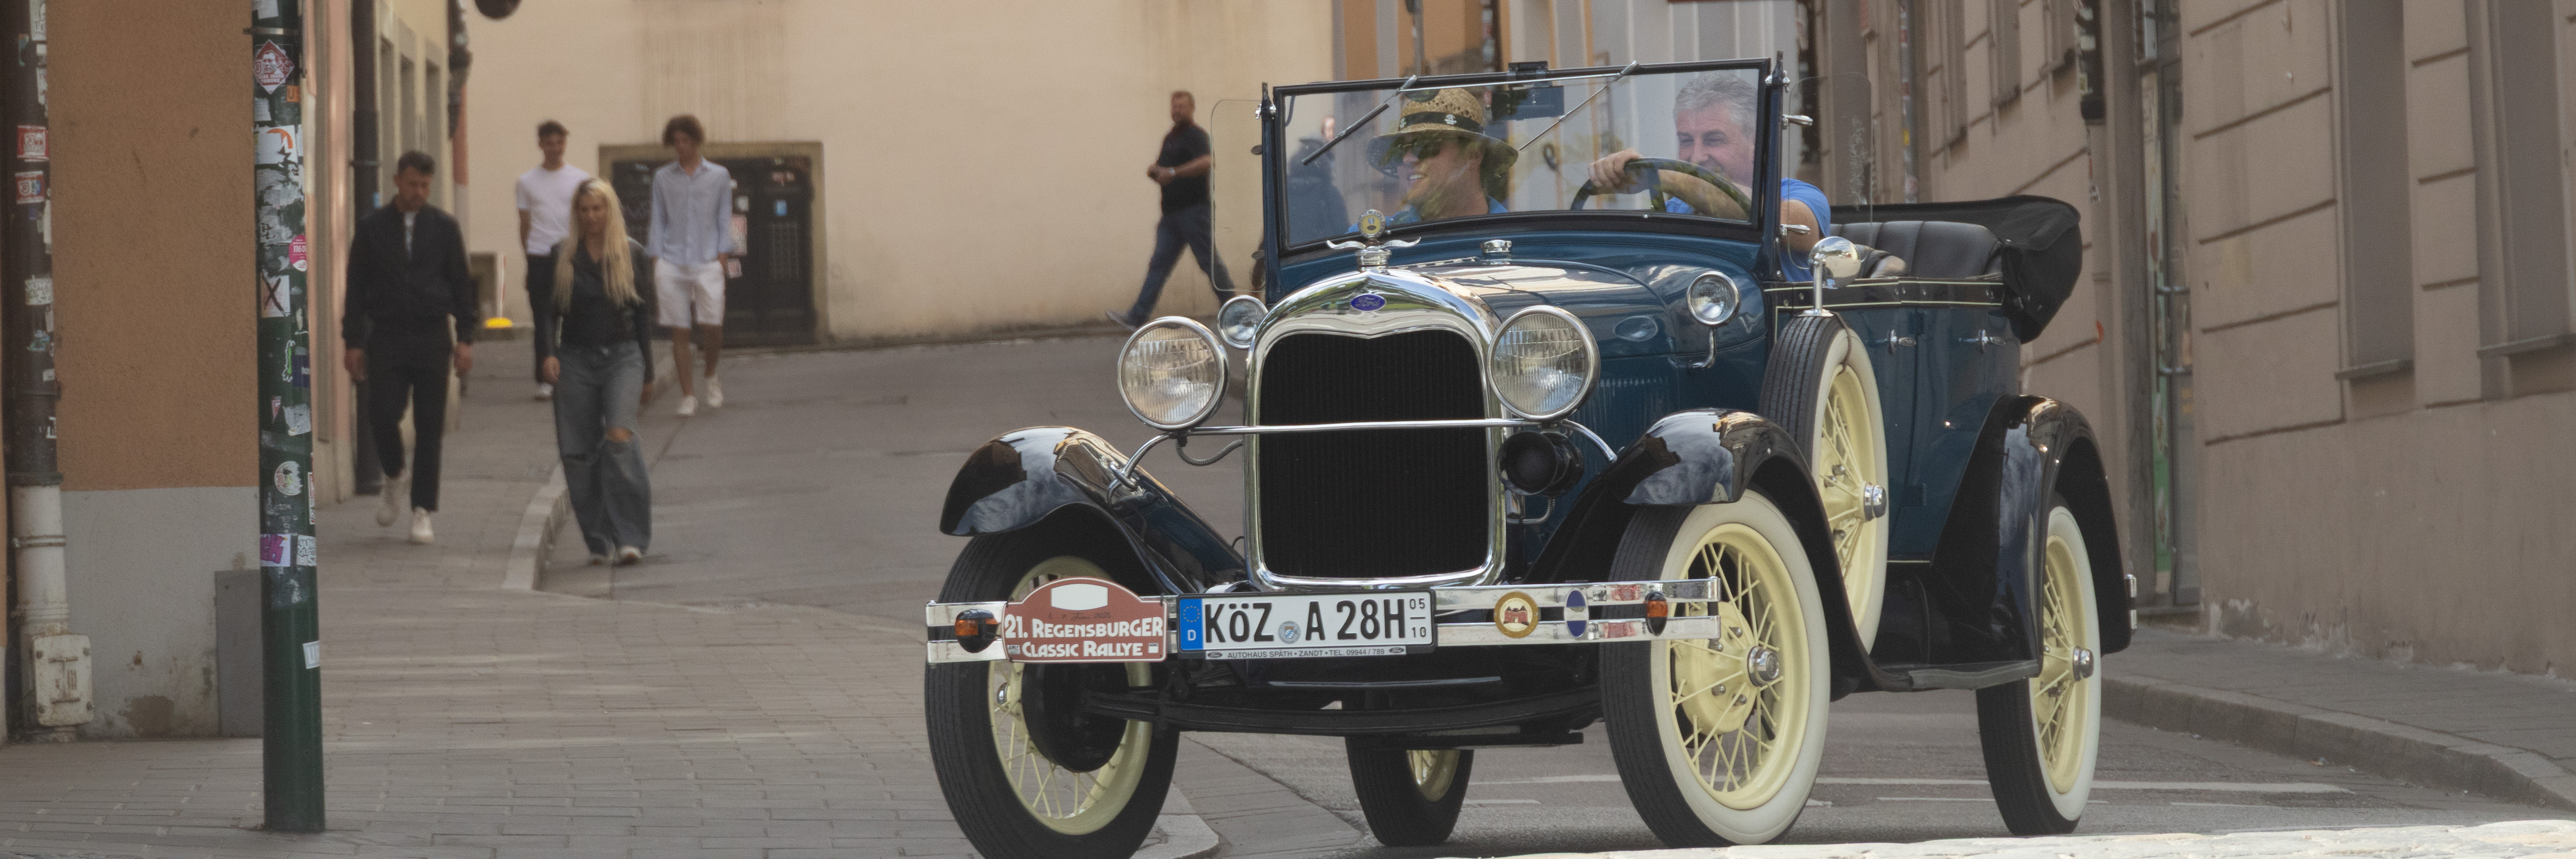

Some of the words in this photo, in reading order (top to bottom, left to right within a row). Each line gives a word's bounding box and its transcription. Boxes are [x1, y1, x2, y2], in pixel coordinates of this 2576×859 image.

[1355, 296, 1381, 307] Ford
[1410, 598, 1425, 609] 05
[1005, 614, 1028, 638] 21.
[1032, 617, 1163, 638] REGENSBURGER
[1305, 601, 1325, 641] A
[1337, 599, 1405, 640] 28H
[1187, 629, 1197, 641] D
[1412, 627, 1426, 638] 10
[1022, 641, 1079, 657] CLASSIC
[1084, 640, 1143, 656] RALLYE
